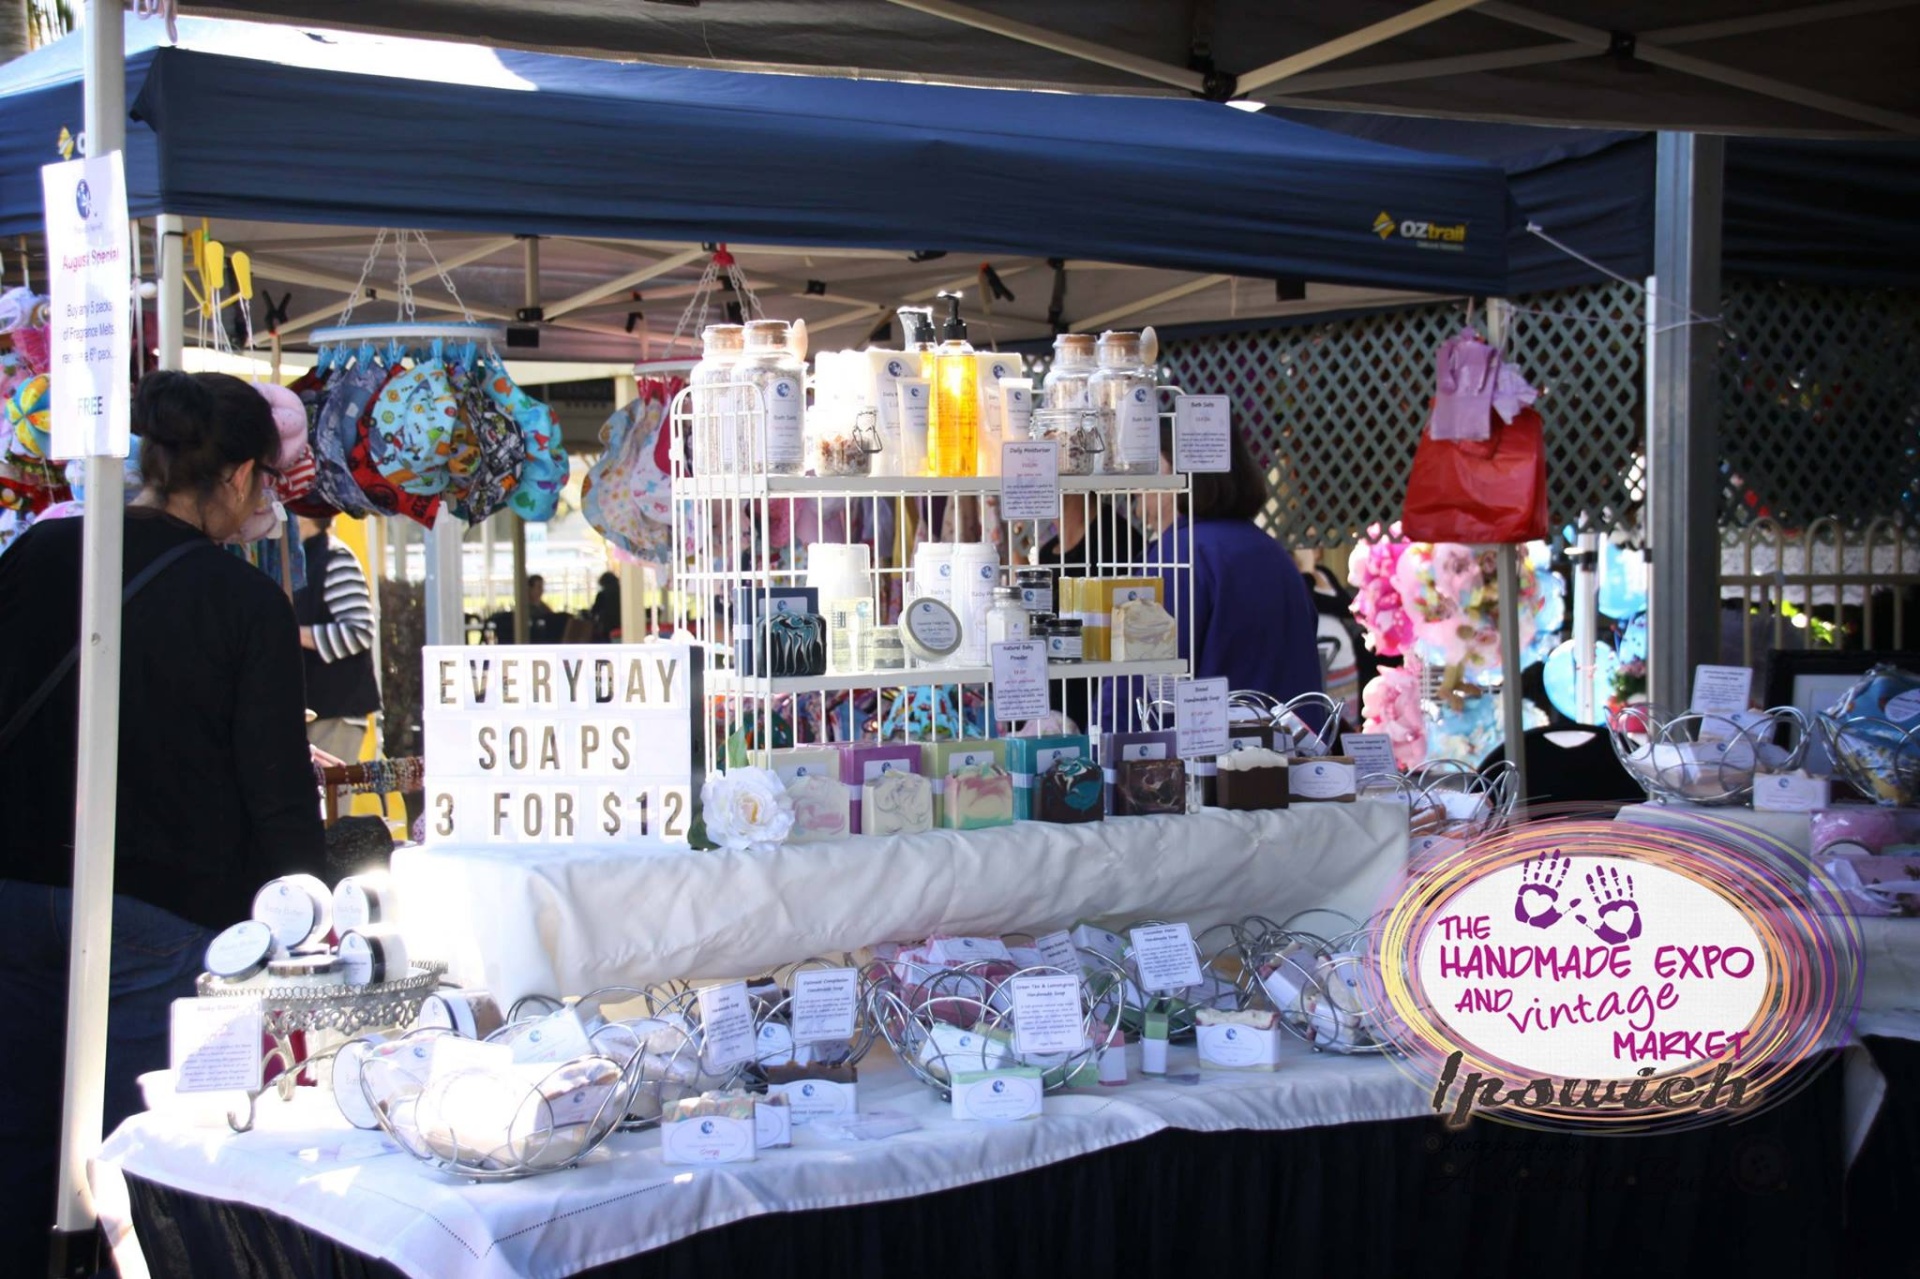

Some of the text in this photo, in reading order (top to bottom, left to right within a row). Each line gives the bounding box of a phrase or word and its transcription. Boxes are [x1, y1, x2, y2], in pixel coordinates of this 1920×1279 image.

[62, 248, 119, 272] August Special
[67, 303, 79, 319] Buy
[96, 301, 113, 315] packs
[78, 396, 103, 415] FREE
[439, 658, 677, 704] EVERYDAY
[478, 725, 631, 770] SOAPS
[435, 791, 683, 837] 3 FOR $12
